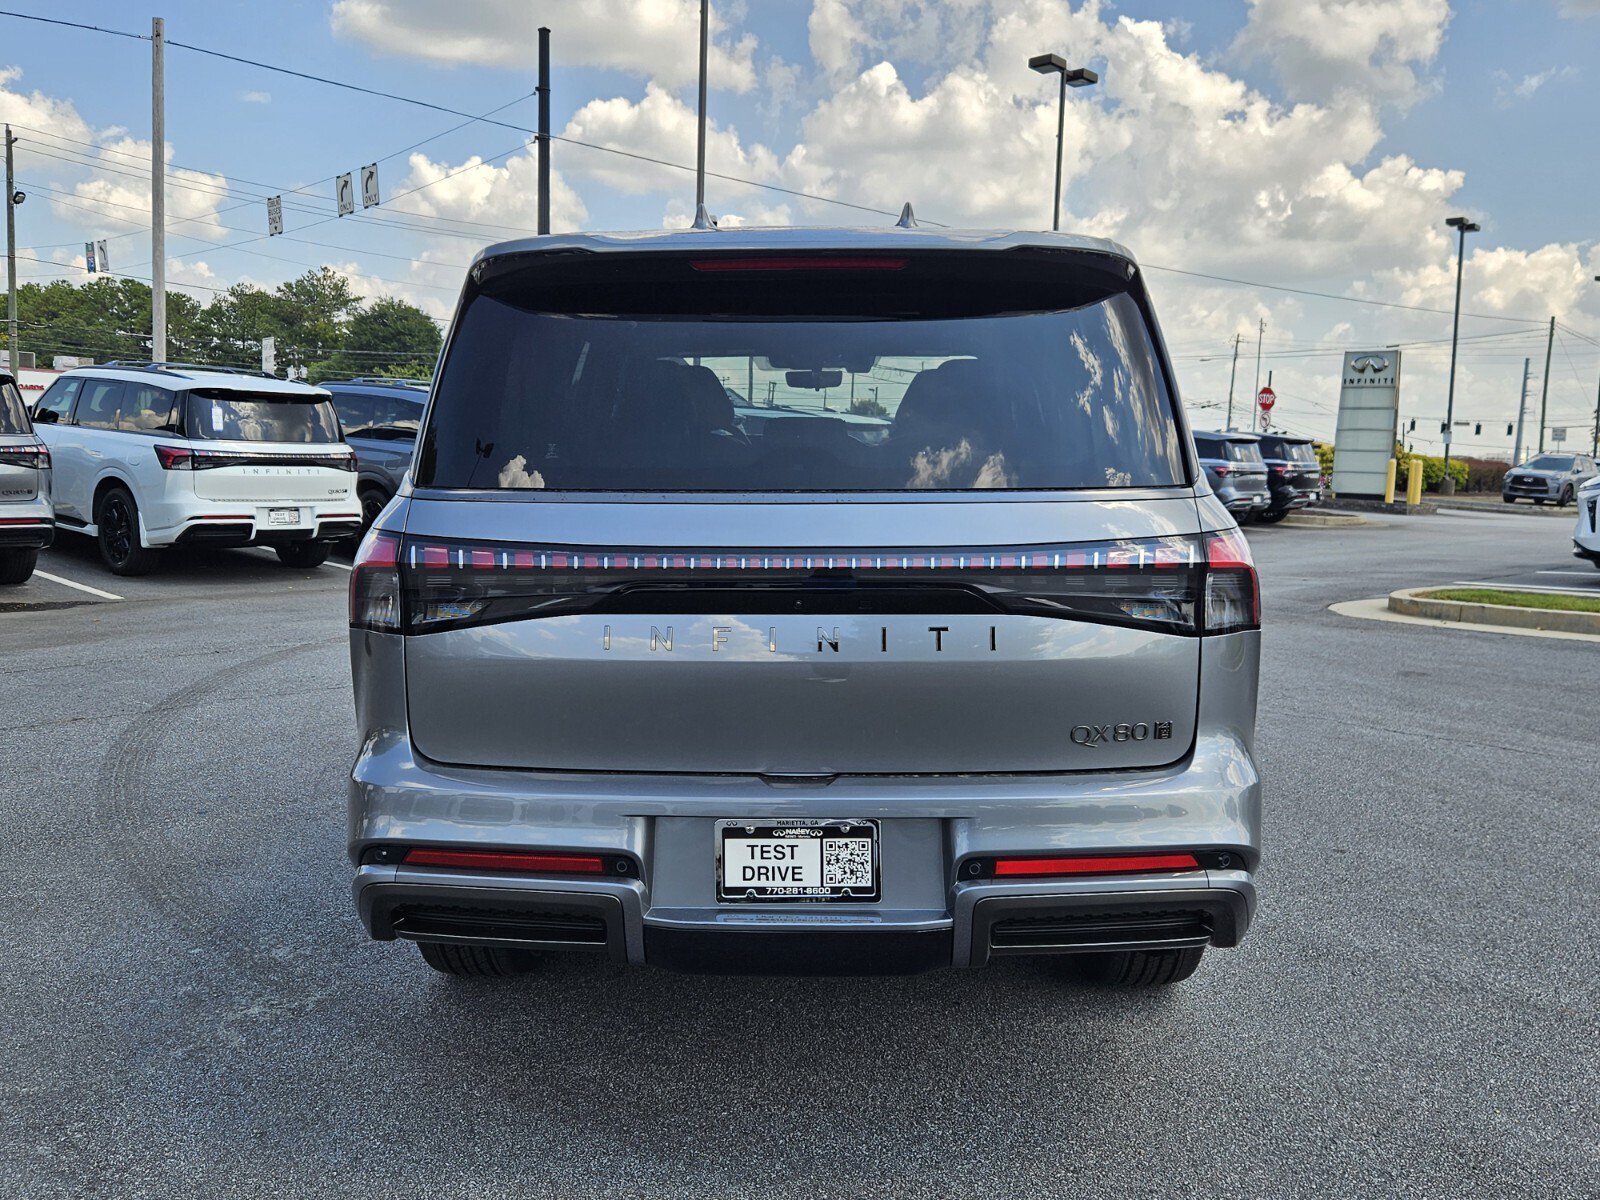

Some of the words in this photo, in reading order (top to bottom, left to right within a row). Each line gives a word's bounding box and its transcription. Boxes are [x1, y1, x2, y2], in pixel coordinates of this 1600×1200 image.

[365, 194, 376, 203] ONLY
[1343, 377, 1394, 385] INFINITI
[1258, 393, 1275, 404] STOP
[603, 625, 997, 652] INFINITI
[1070, 722, 1150, 748] QX80
[746, 844, 799, 860] TEST
[742, 865, 804, 882] DRIVE
[765, 887, 831, 895] 770-281-8600
